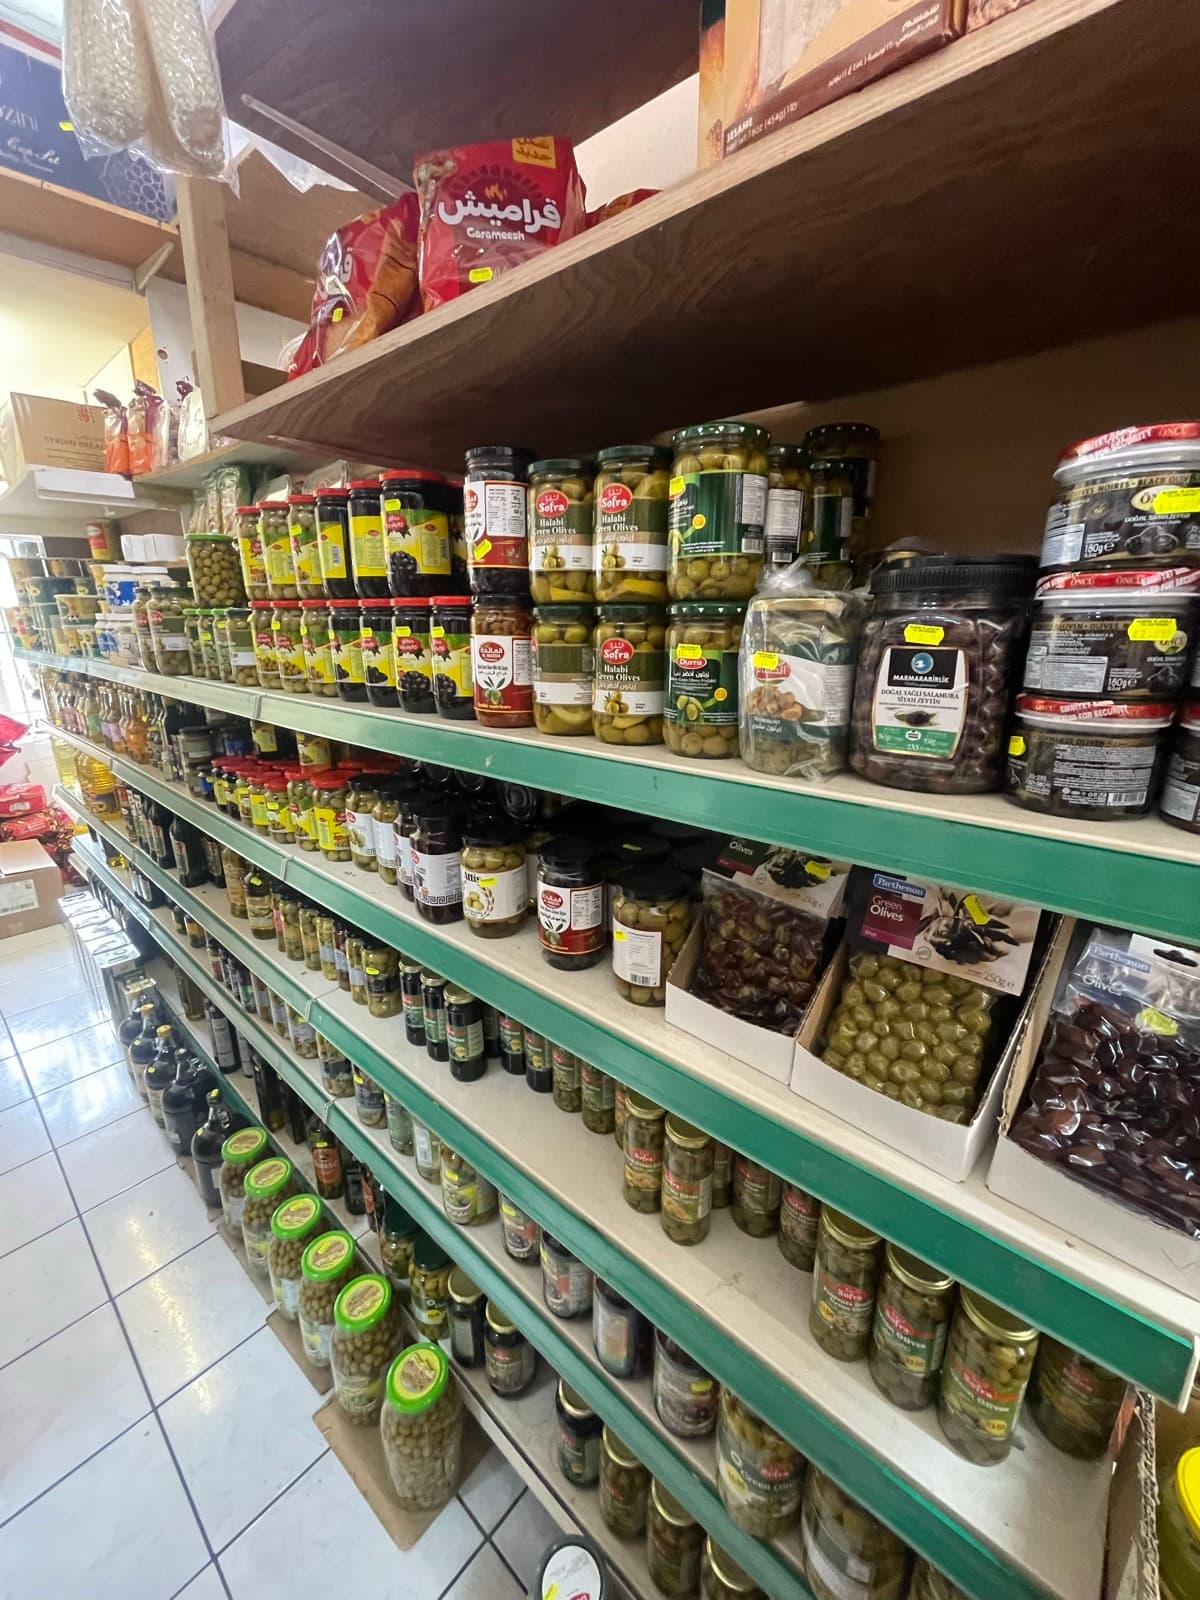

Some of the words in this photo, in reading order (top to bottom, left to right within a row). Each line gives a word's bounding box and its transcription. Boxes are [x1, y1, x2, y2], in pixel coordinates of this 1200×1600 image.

[902, 4, 940, 33] سمسم
[727, 116, 753, 143] SESAME
[438, 190, 561, 234] قراميش
[1098, 481, 1130, 493] NOIRES
[1137, 476, 1167, 488] BLACK
[538, 502, 565, 513] Sofra
[601, 496, 627, 508] Sofra
[540, 518, 564, 527] Halabi
[602, 514, 626, 523] Halabi
[551, 526, 577, 535] Olives
[612, 523, 639, 532] Olives
[604, 650, 629, 661] Sofra
[604, 664, 628, 674] Halabi
[616, 674, 640, 682] Olives
[897, 696, 916, 704] SİYAH
[917, 697, 941, 705] ZEYTİN
[729, 841, 753, 856] Olives
[877, 877, 924, 896] Parthenon
[872, 895, 902, 911] Green
[870, 904, 904, 922] Olives
[1094, 946, 1148, 971] Parthenon
